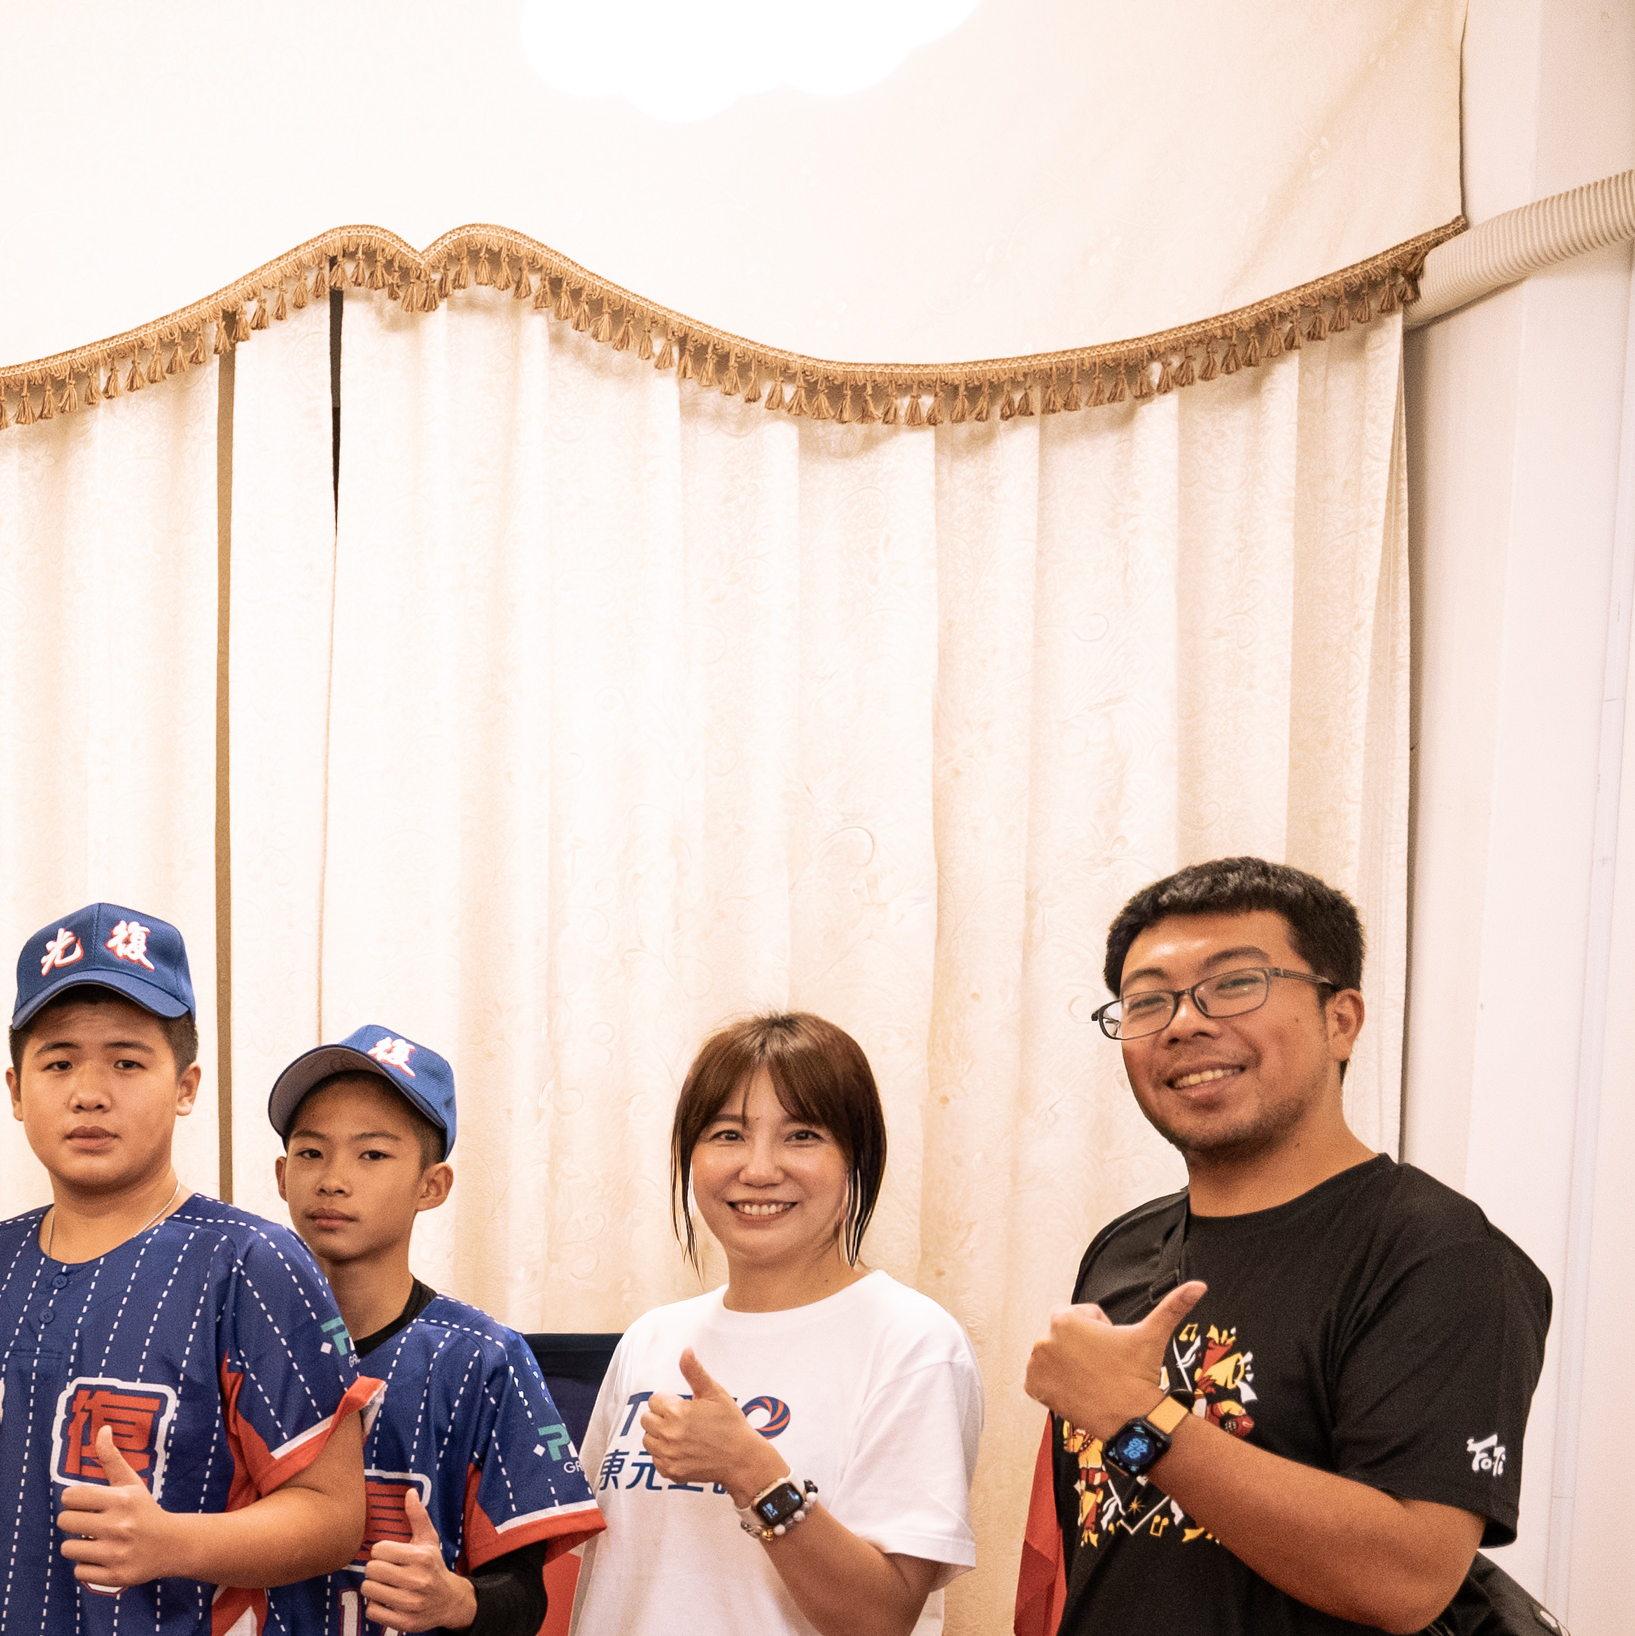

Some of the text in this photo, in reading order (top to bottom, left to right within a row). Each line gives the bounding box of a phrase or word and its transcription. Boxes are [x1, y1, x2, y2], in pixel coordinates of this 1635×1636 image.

[40, 918, 157, 977] 光復
[620, 1391, 791, 1440] TO
[599, 1449, 729, 1495] 東元
